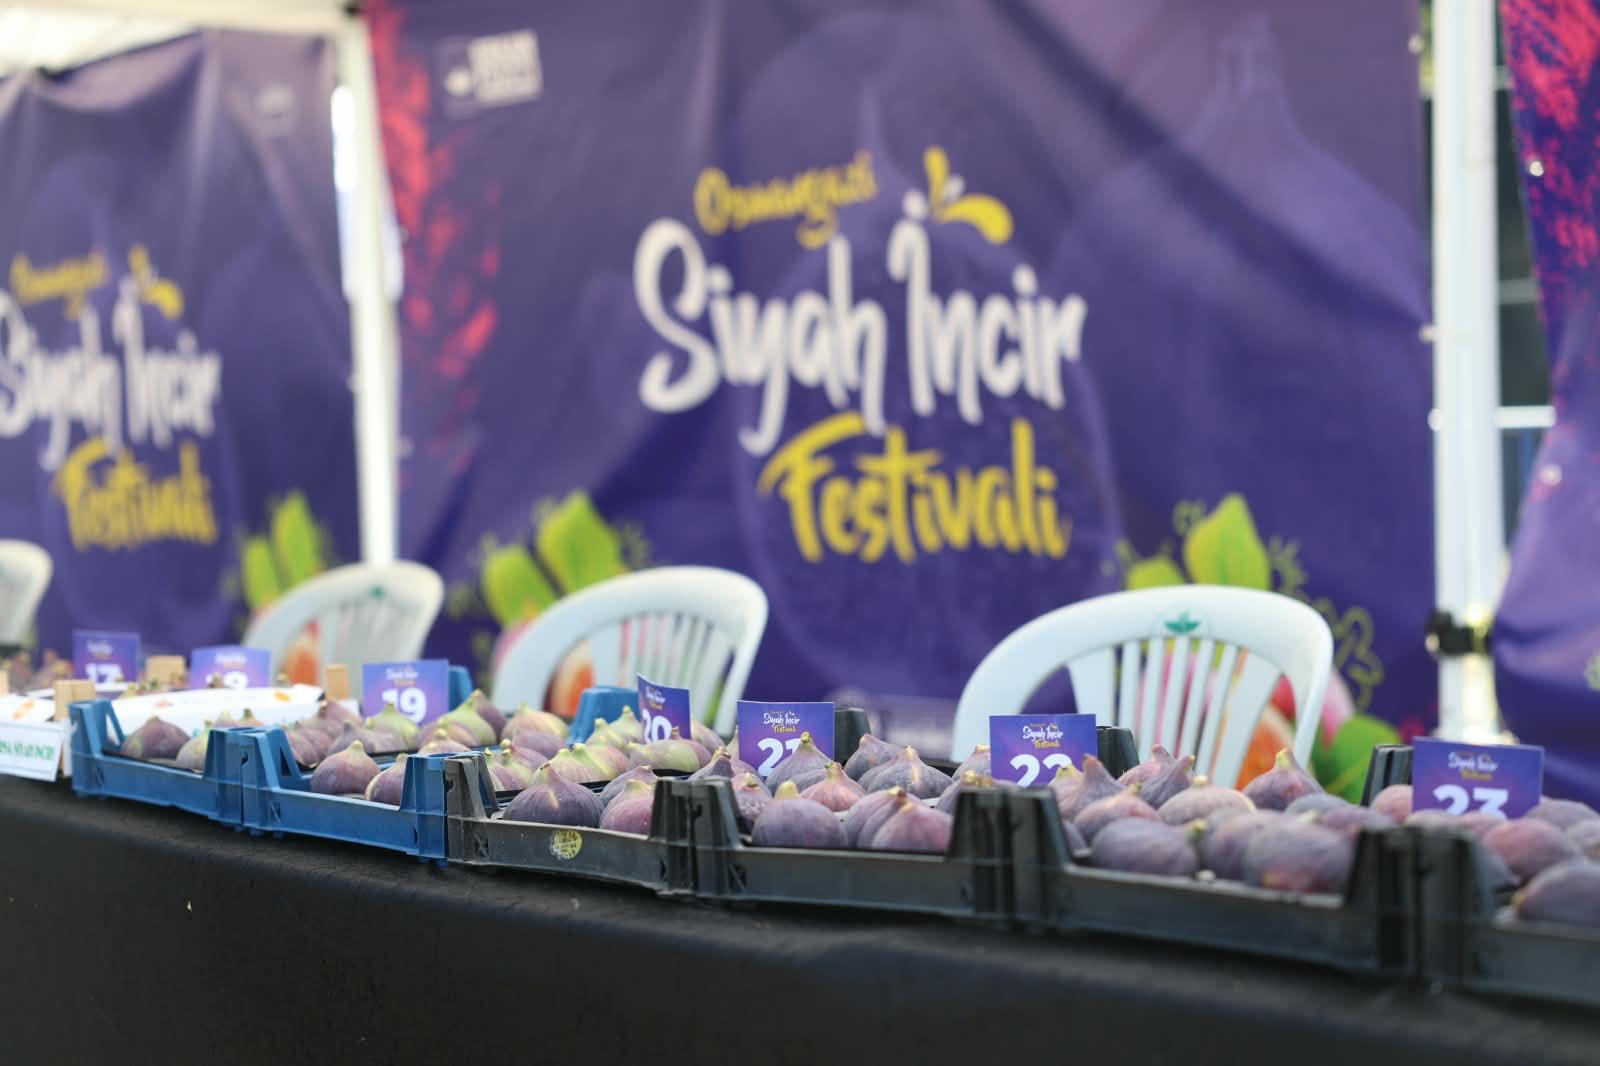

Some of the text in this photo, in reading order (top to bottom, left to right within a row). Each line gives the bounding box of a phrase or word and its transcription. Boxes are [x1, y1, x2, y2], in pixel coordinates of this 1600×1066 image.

[633, 217, 887, 456] Siyah
[757, 411, 1072, 564] Festivali
[381, 688, 427, 724] 19
[1433, 784, 1509, 820] 23
